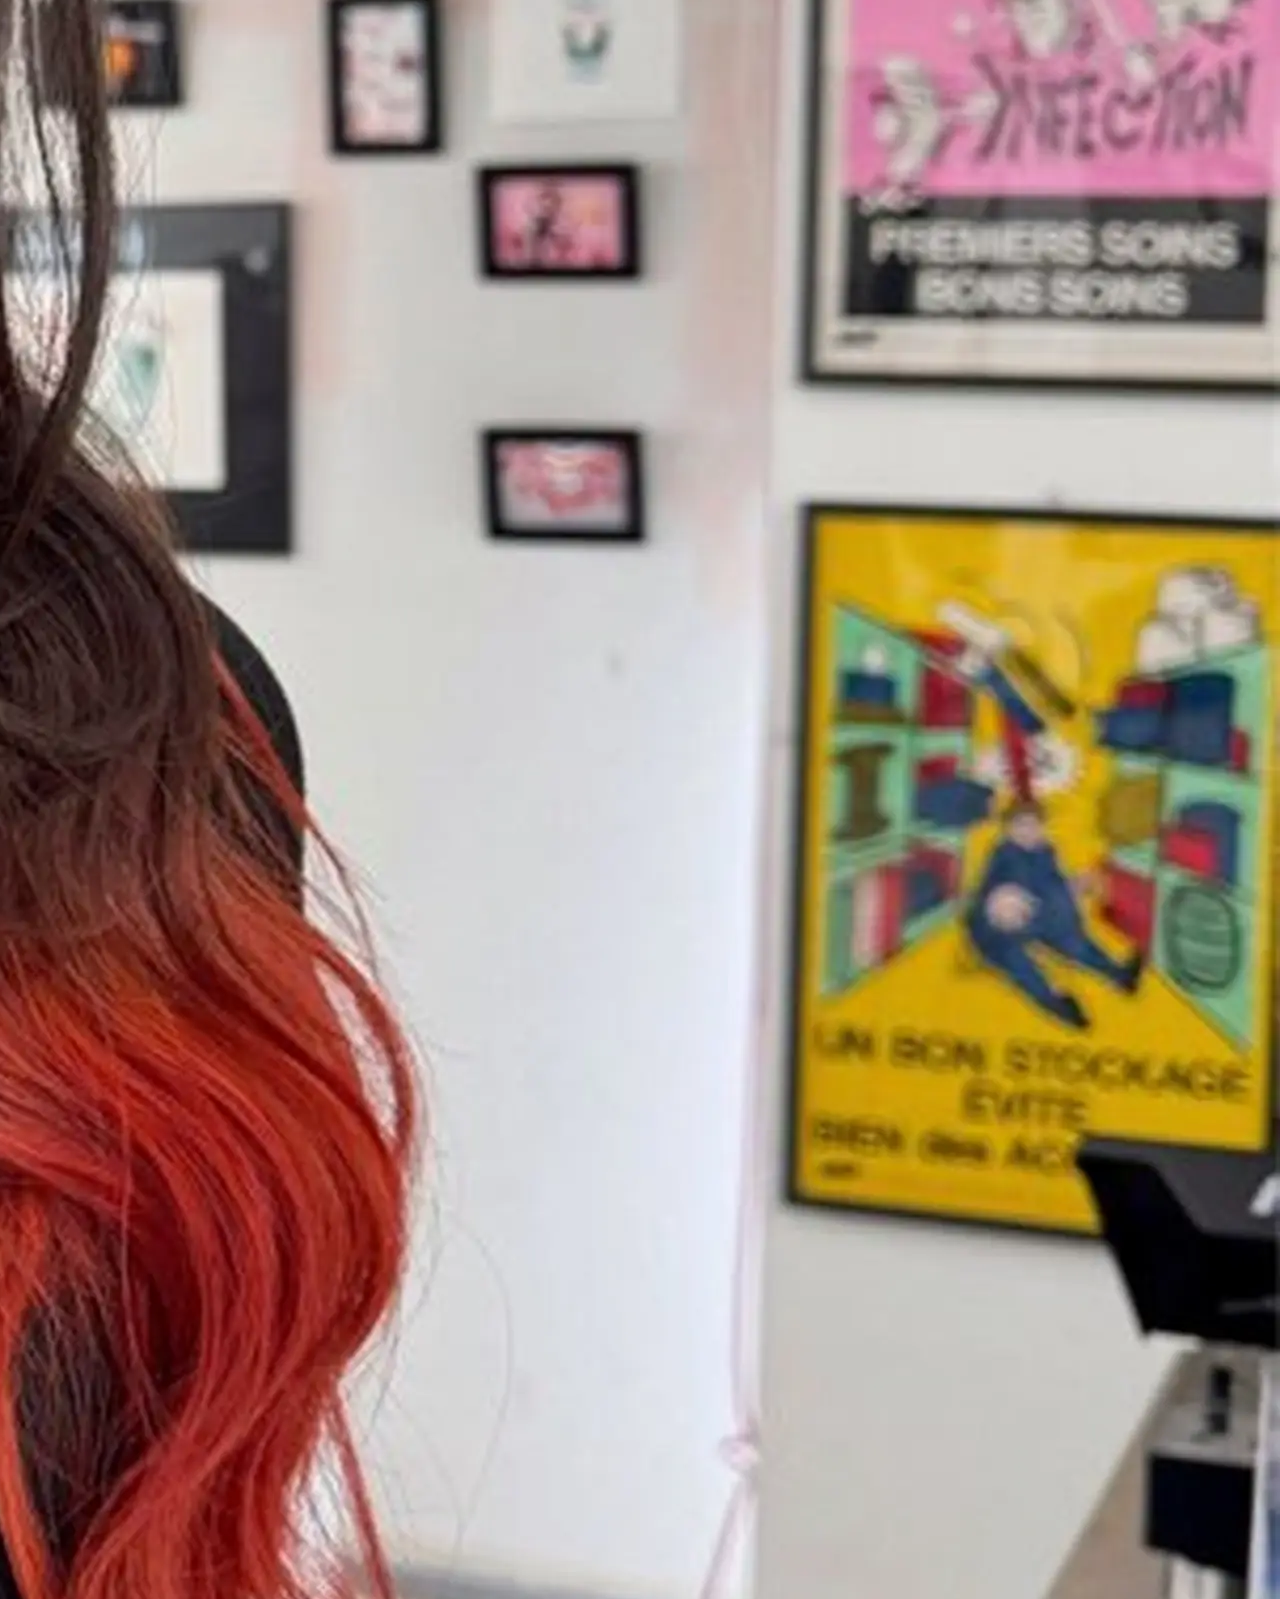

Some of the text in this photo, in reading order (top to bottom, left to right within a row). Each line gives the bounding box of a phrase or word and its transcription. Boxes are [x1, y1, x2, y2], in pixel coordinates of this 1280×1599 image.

[869, 220, 1241, 270] PREMIERS SOINS
[914, 268, 1190, 317] BONS SOINS
[889, 1028, 986, 1073] BON
[1003, 1037, 1253, 1102] STOCKAGE
